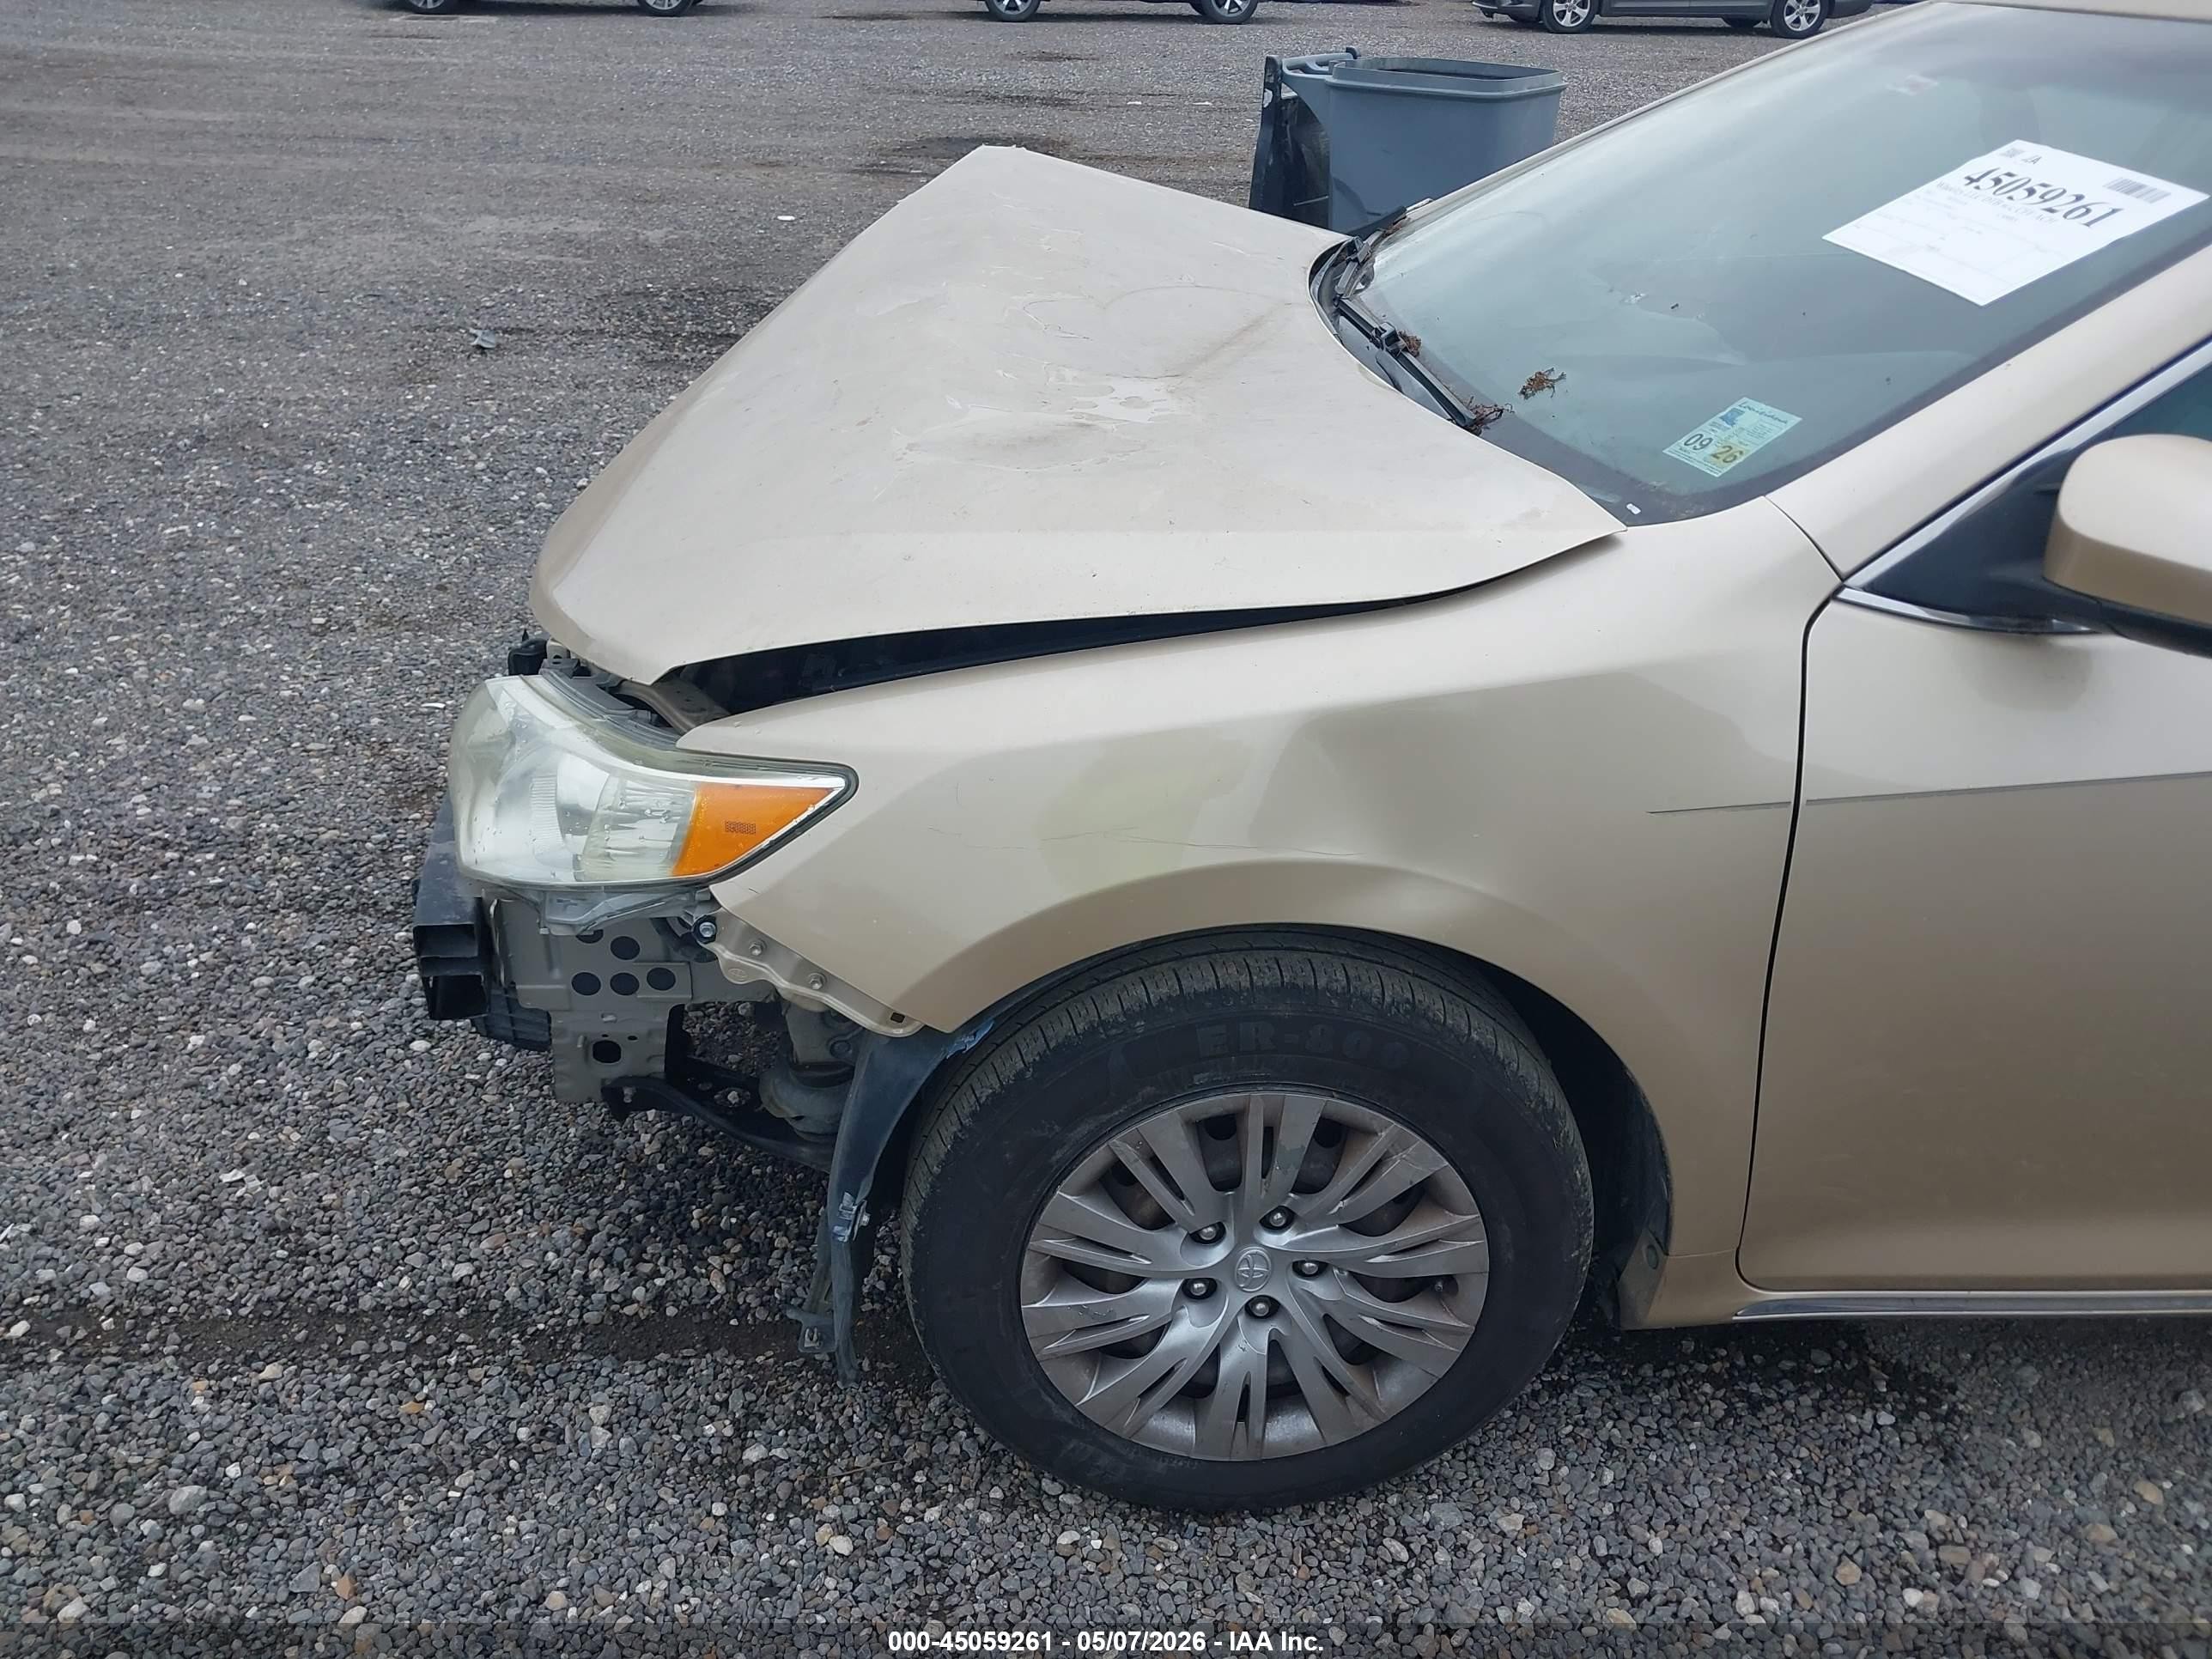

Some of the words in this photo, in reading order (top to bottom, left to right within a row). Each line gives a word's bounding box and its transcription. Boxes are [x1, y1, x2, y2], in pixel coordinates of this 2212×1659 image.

[1964, 167, 2124, 228] 45059261
[1683, 433, 1713, 452] 09
[1711, 445, 1744, 464] 26
